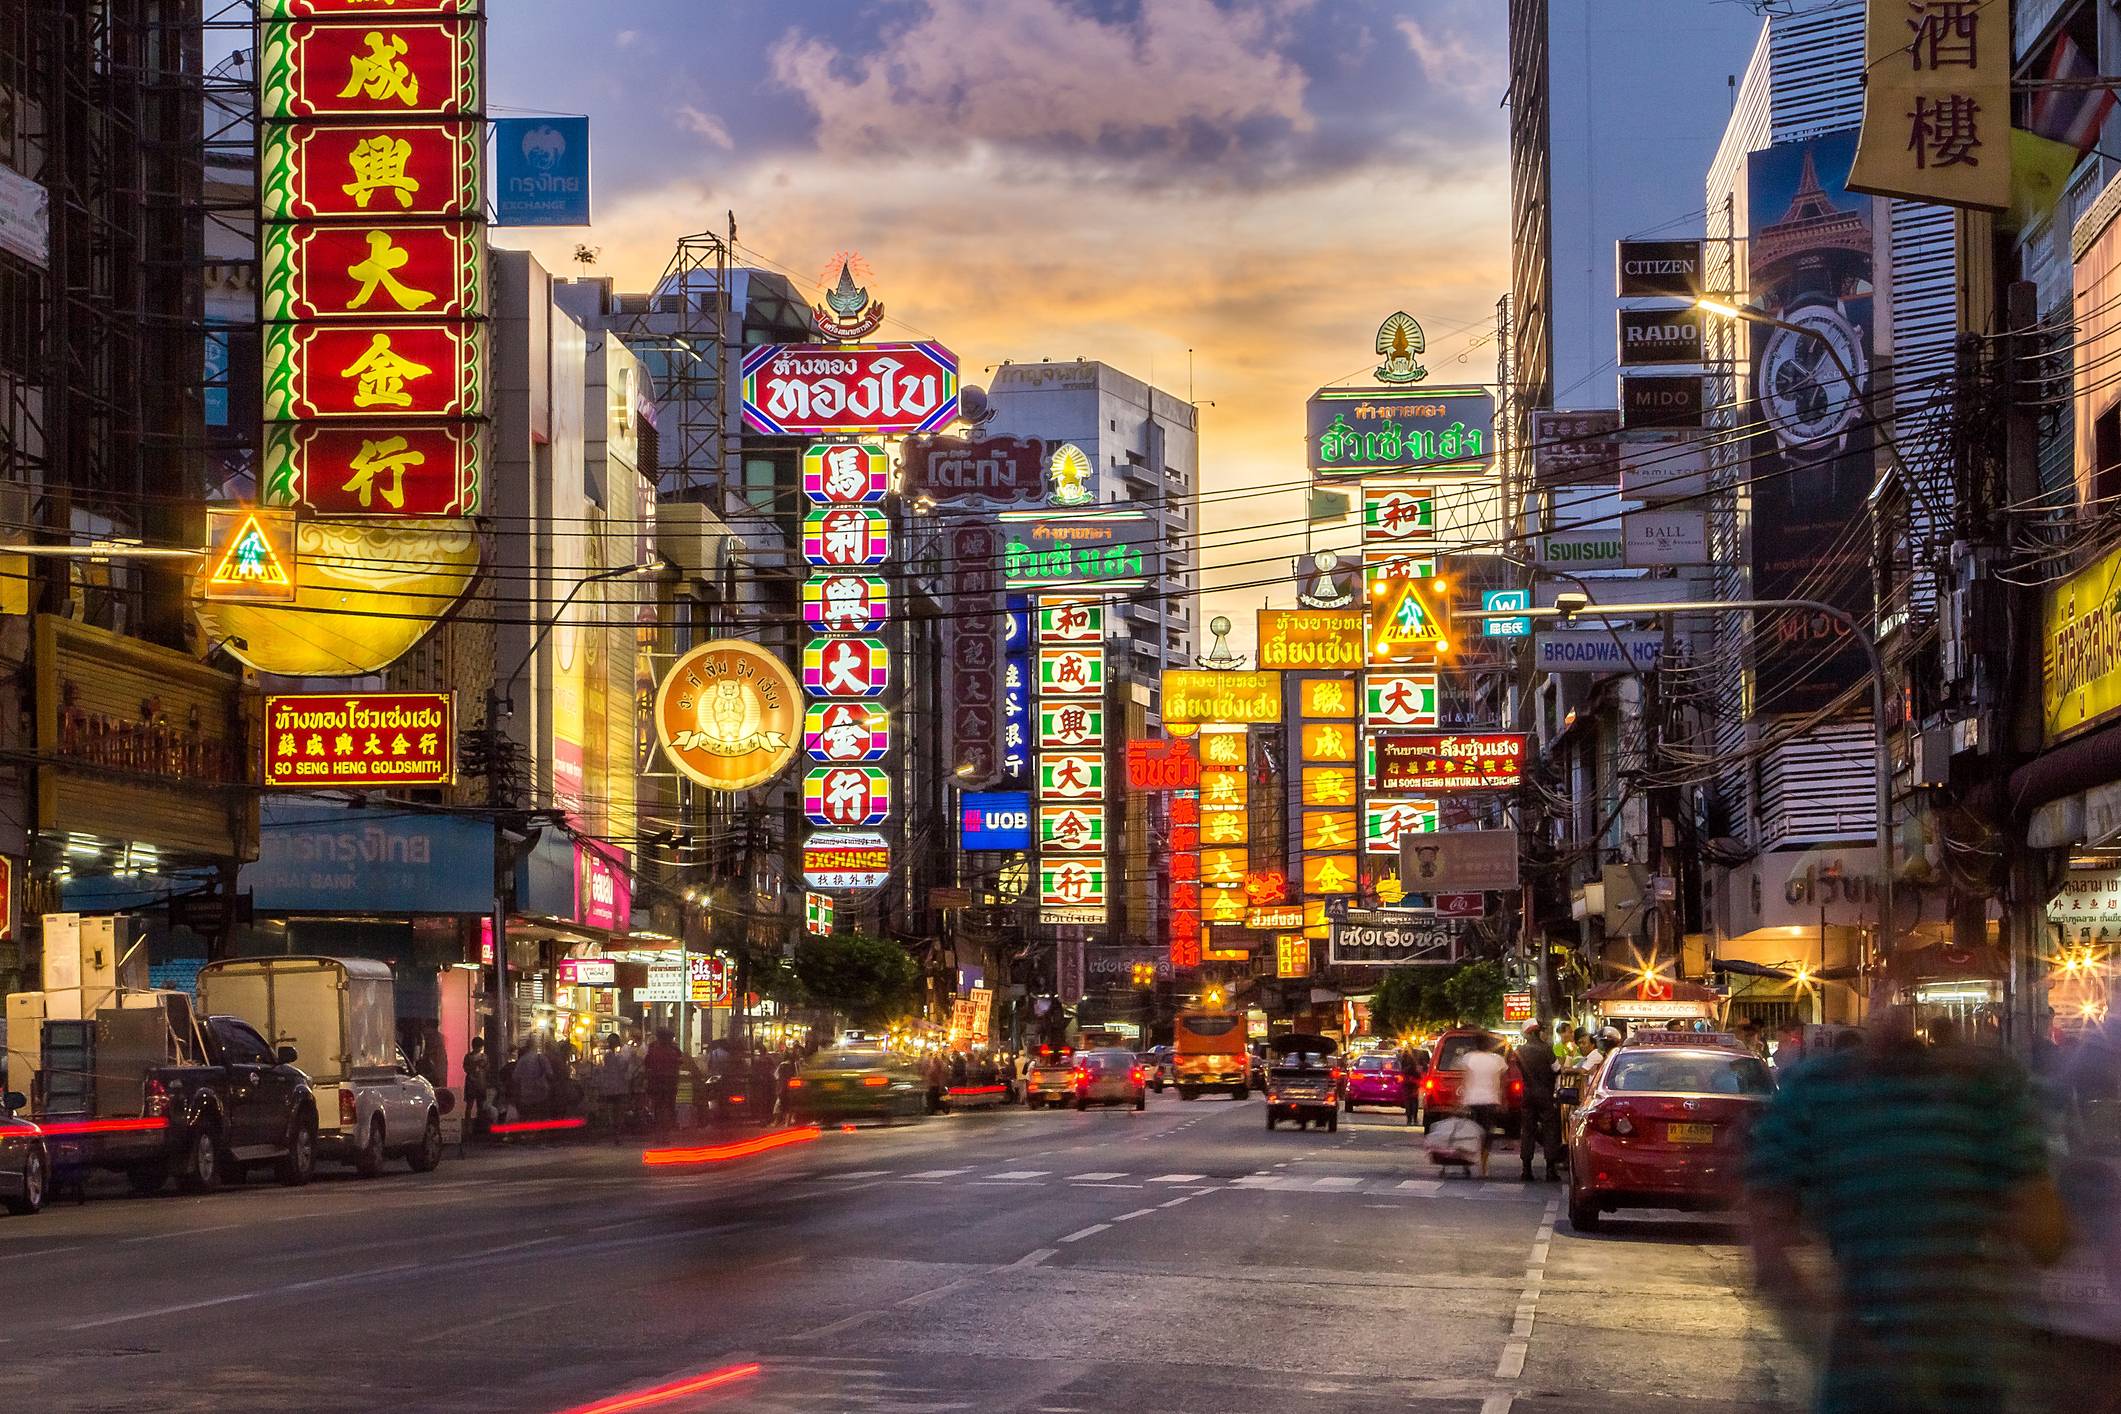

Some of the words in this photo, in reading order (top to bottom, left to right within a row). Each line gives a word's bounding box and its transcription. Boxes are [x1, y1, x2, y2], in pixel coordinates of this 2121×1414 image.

[1906, 0, 1982, 169] 酒樓
[510, 172, 579, 200] กรุงไทย
[336, 0, 437, 508] 成興大金行
[1625, 259, 1695, 275] CITIZEN
[1627, 324, 1697, 342] RADO
[773, 352, 858, 376] ห้างทอง
[1636, 391, 1689, 406] MIDO
[1353, 402, 1447, 420] ห้างขายทอง
[1319, 413, 1484, 463] ฮั่วเซ่งเฮง
[928, 449, 1017, 488] โต๊ะกัง
[1644, 526, 1685, 538] BALL
[1004, 533, 1143, 578] ฮั่วเซ่งเฮง
[1542, 536, 1623, 562] โรงแรมบร
[1276, 613, 1363, 631] ห้างขายทอ
[1264, 632, 1363, 664] เลี่ยงเซ่งเ
[1544, 641, 1628, 662] BROADWAY
[1176, 673, 1267, 689] ห้างขายทอง
[275, 701, 441, 729] ห้างทองโซวเซ่งเฮง
[1055, 603, 1090, 898] 和成興大金行
[275, 763, 292, 775] SO
[296, 762, 329, 775] SENG
[333, 762, 367, 775] HENG
[371, 760, 442, 774] GOLDSMITH
[1383, 779, 1398, 789] LIM
[1399, 778, 1421, 788] SOON
[1422, 777, 1444, 787] HENG
[1445, 777, 1480, 787] NATURAL
[1482, 775, 1521, 786] MEDICINE
[1311, 682, 1352, 935] 聯成興大金
[985, 812, 1028, 830] UOB
[1209, 734, 1244, 958] 聯成興大金
[804, 852, 887, 868] EXCHANGE
